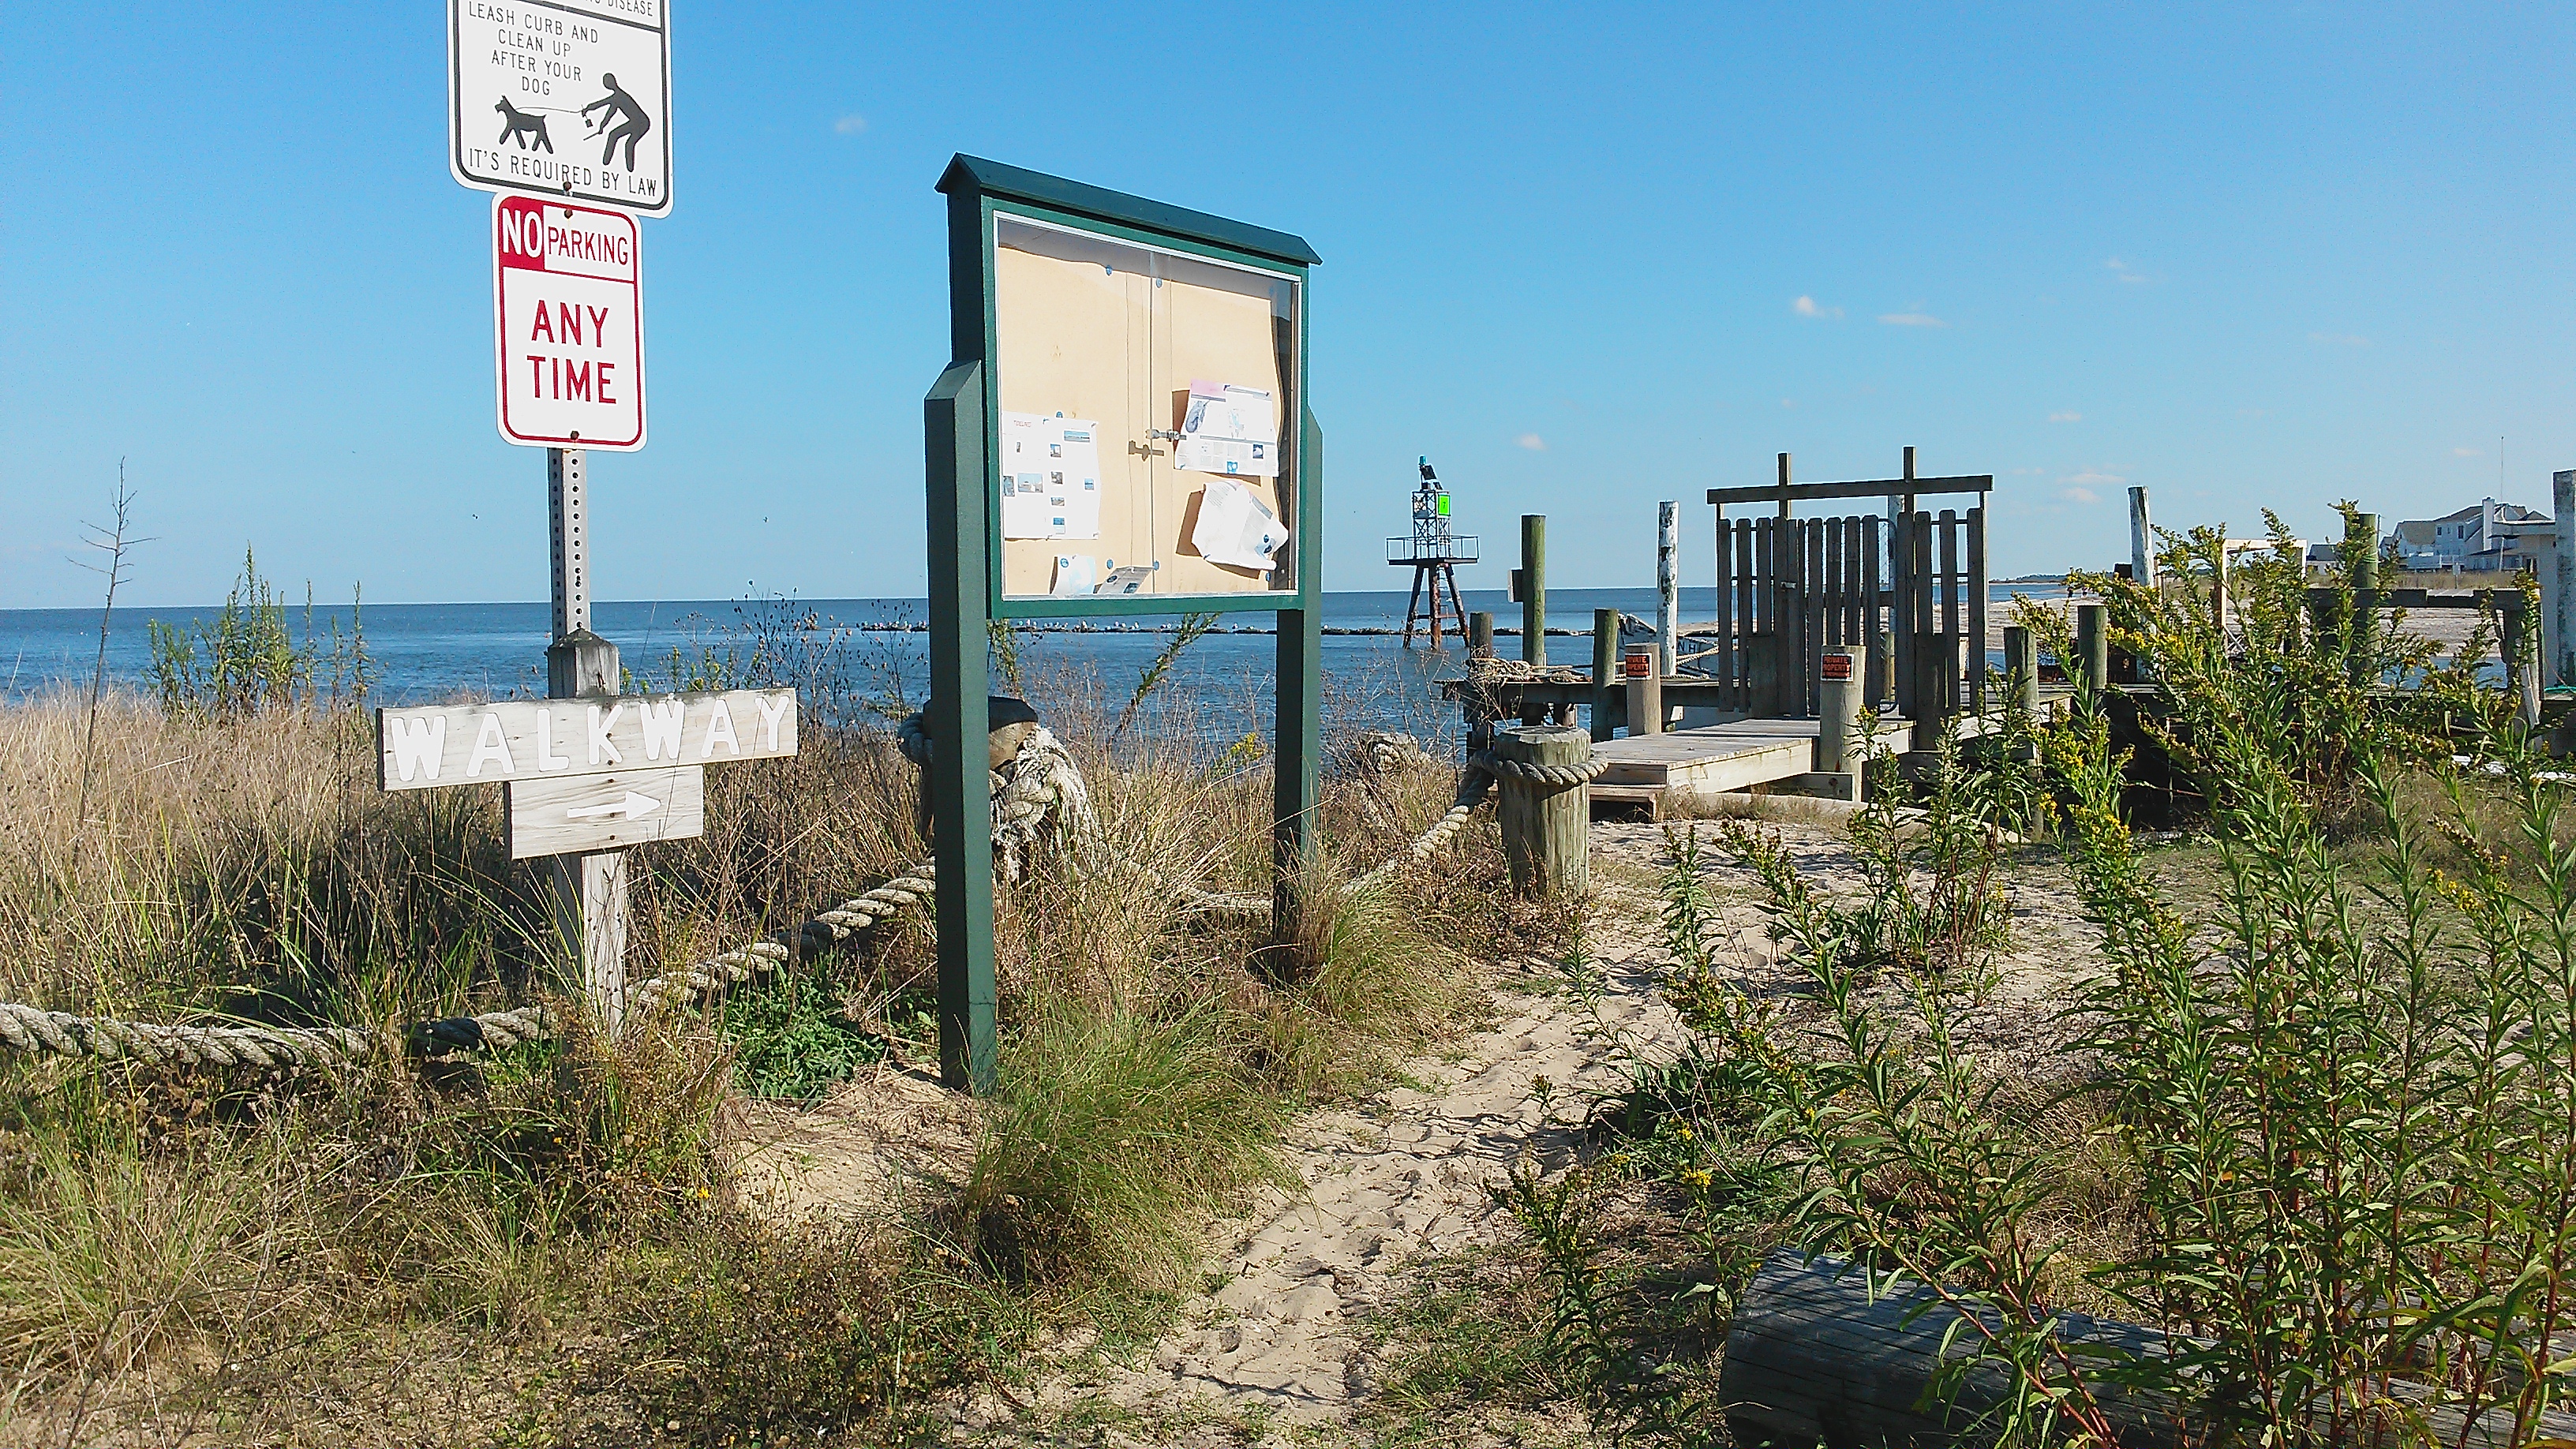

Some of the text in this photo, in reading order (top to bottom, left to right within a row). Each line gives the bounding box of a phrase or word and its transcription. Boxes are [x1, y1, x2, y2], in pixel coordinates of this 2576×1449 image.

[469, 2, 598, 43] LEASH CURB AND
[498, 28, 571, 58] CLEAN UP
[492, 50, 582, 81] AFTER YOUR
[522, 76, 550, 95] DOG
[470, 148, 657, 197] IT'S REQUIRED BY LAW
[502, 208, 628, 265] NO PARKING
[531, 299, 608, 348] ANY
[526, 355, 616, 404] TIME
[390, 695, 790, 782] WALKWAY
